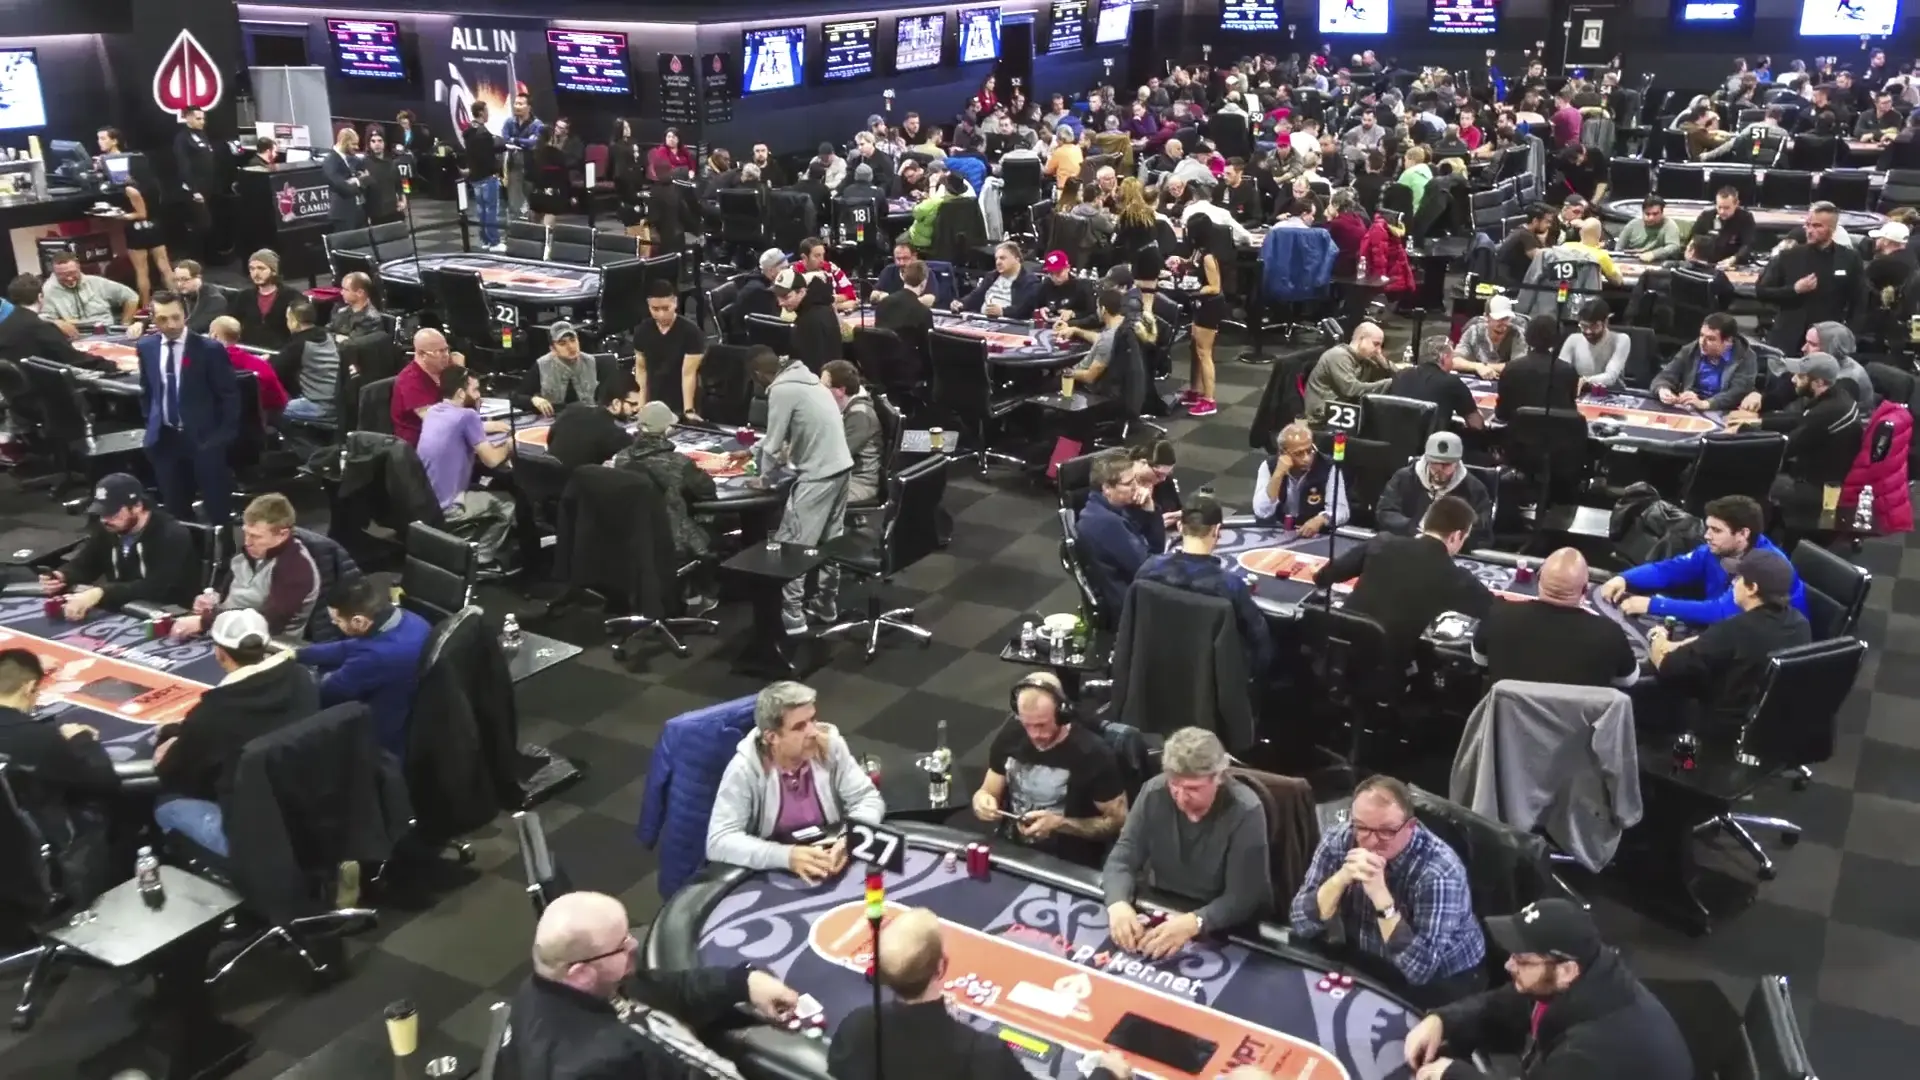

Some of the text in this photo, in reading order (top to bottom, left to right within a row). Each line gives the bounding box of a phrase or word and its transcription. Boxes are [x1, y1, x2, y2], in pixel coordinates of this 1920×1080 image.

[451, 26, 517, 53] ALL IN
[1341, 85, 1351, 94] 53
[1251, 112, 1264, 123] 50
[1752, 128, 1766, 138] 51
[853, 208, 867, 222] 18
[1553, 262, 1574, 279] 19
[496, 304, 515, 324] 22
[1327, 405, 1356, 429] 23
[851, 824, 899, 866] 27
